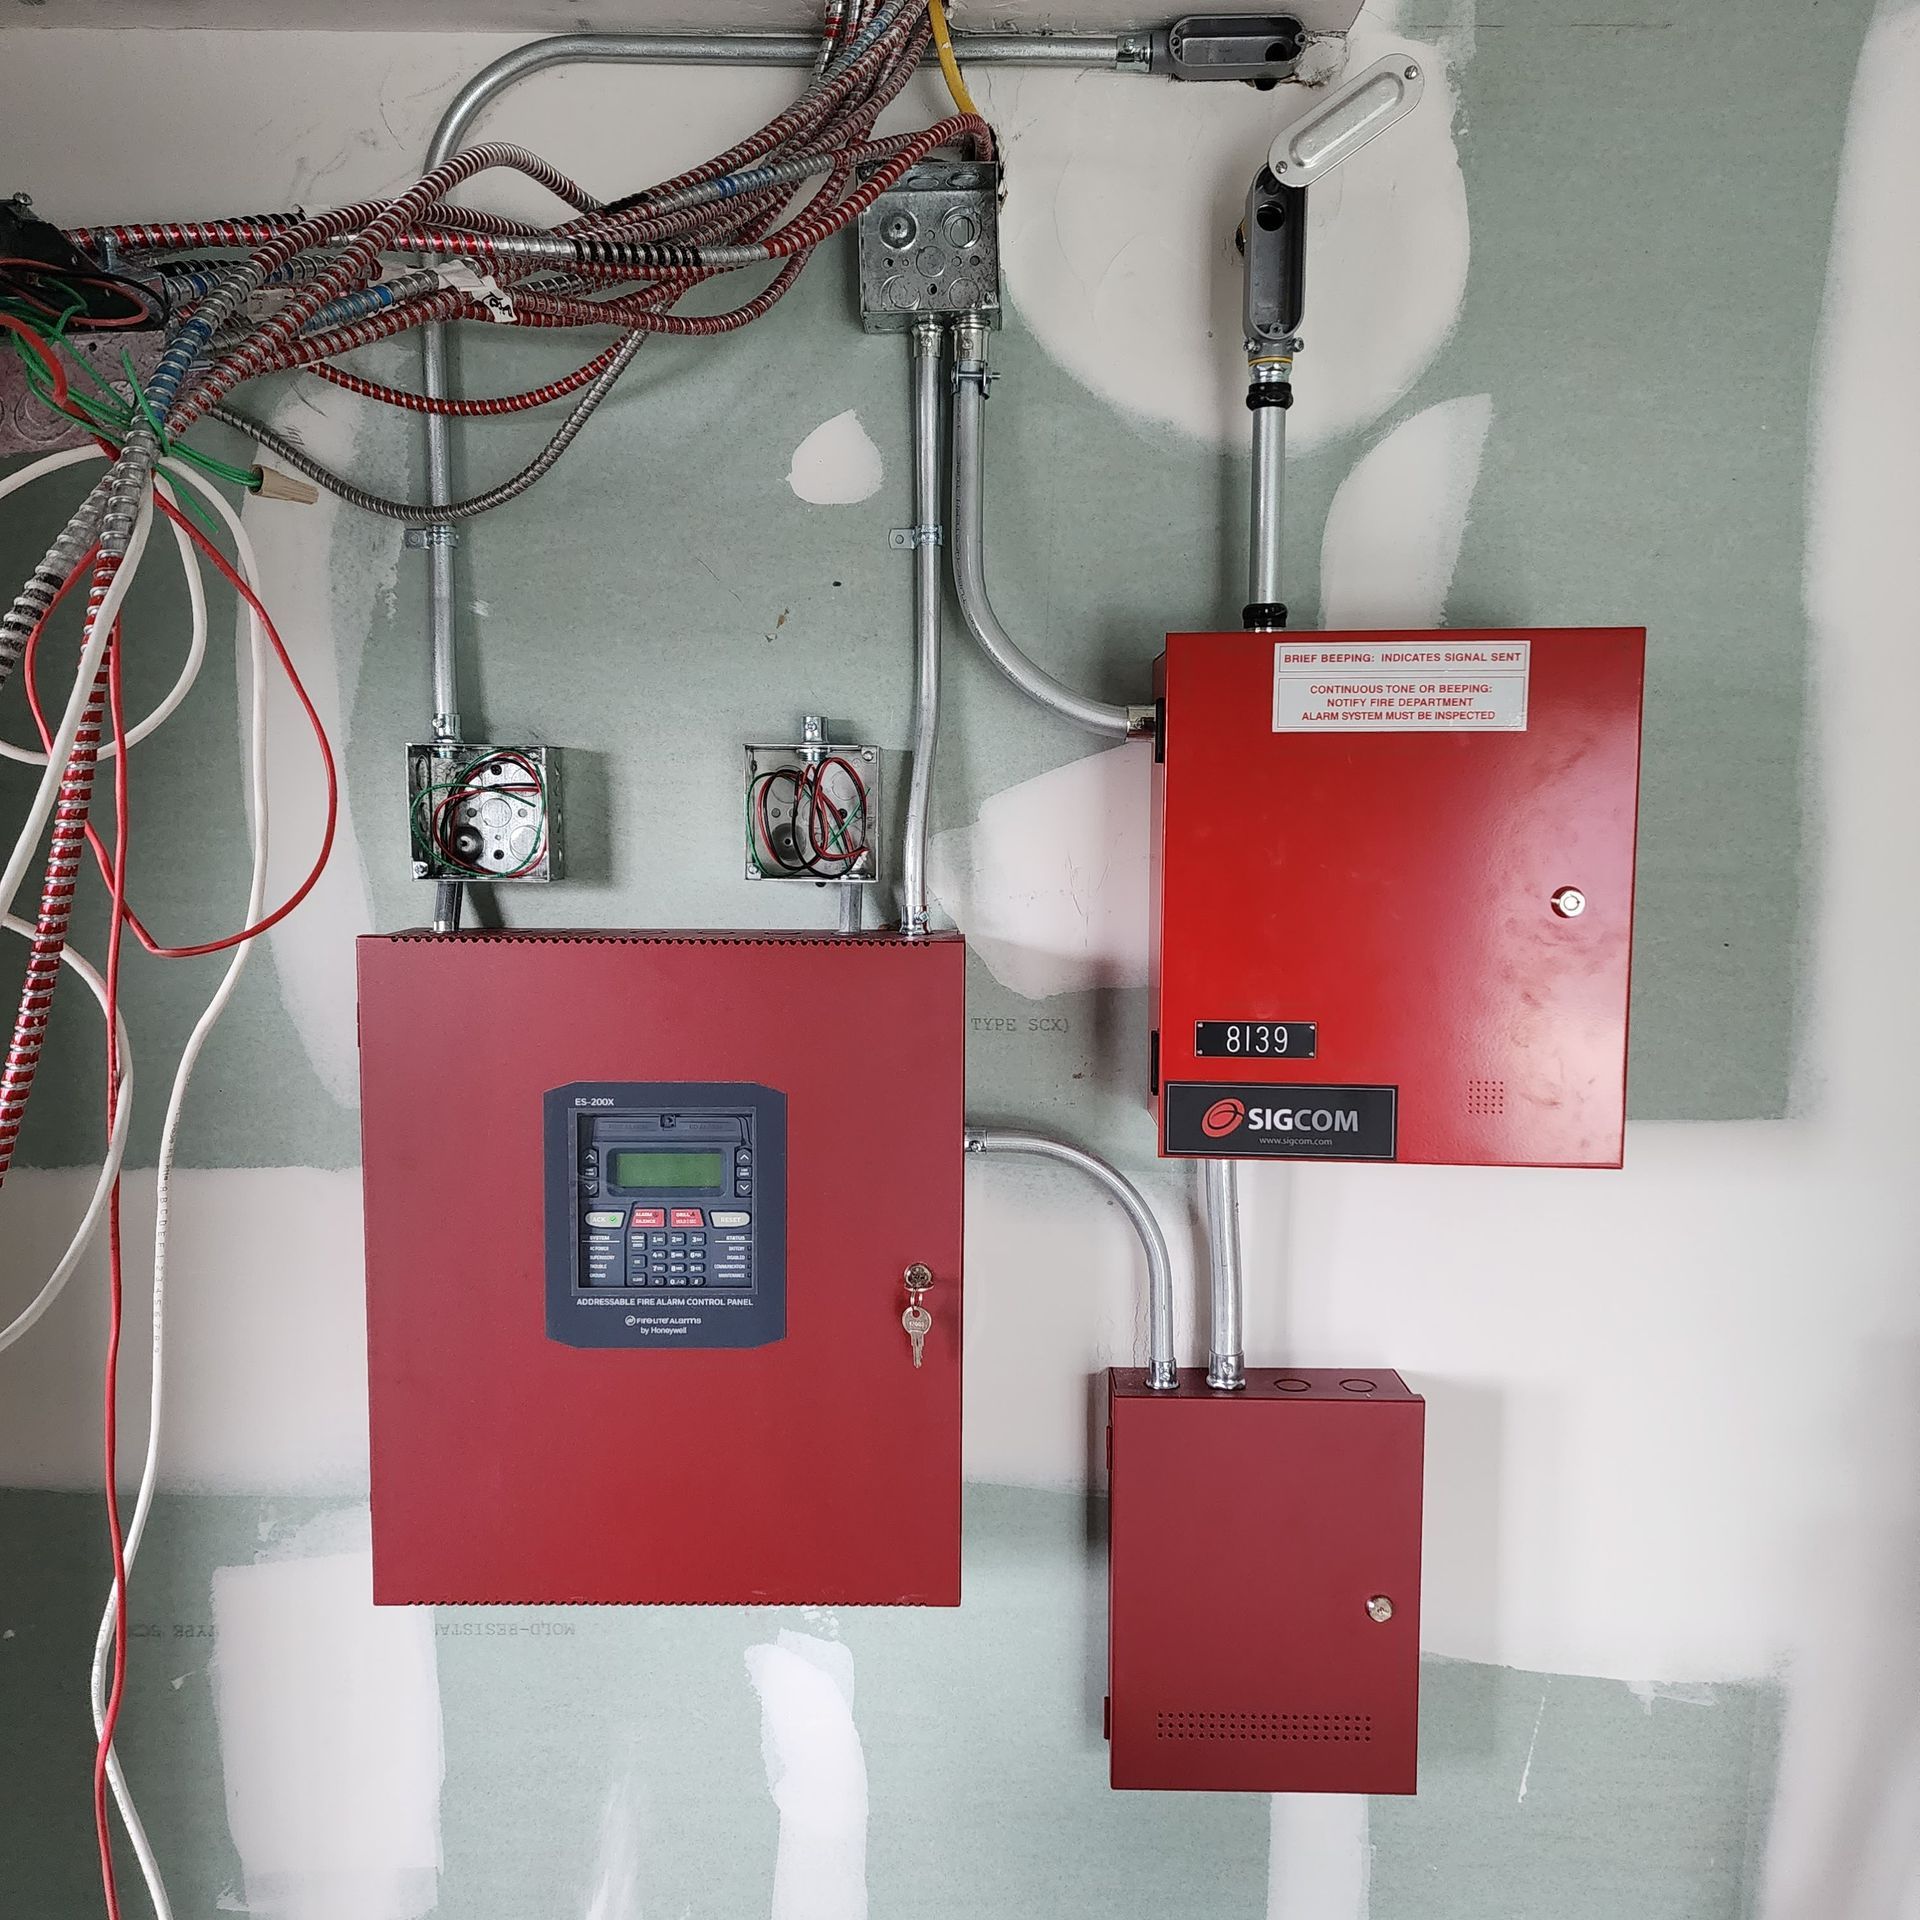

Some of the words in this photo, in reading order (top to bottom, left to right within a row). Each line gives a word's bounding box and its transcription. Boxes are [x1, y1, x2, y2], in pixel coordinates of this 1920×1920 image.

[1284, 654, 1317, 663] BRIEF
[1321, 654, 1375, 663] BEEPING:
[1381, 653, 1440, 662] INDICATES
[1444, 653, 1487, 662] SIGNAL
[1491, 652, 1521, 662] SENT
[1310, 685, 1384, 694] CONTINUOUS
[1386, 685, 1415, 694] TONE
[1419, 685, 1436, 694] OR
[1439, 684, 1492, 694] BEEPING:
[1327, 698, 1366, 707] NOTIFY
[1370, 698, 1394, 707] FIRE
[1399, 698, 1474, 707] DEPARTMENT
[1302, 712, 1338, 721] ALARM
[1342, 712, 1383, 721] SYSTEM
[1386, 712, 1415, 720] MUST
[1418, 711, 1432, 720] BE
[1435, 711, 1496, 720] INSPECTED
[971, 1018, 1016, 1031] TYPE
[1028, 1018, 1069, 1034] SCX)
[1226, 1026, 1288, 1053] 8139
[575, 1098, 614, 1106] ES-200X
[1248, 1108, 1359, 1132] SIGCOM
[1259, 1136, 1332, 1146] www.sigcom.com
[640, 1327, 649, 1335] by
[651, 1327, 687, 1335] Honeywell
[436, 1623, 576, 1636] MOLD-RESISTA
